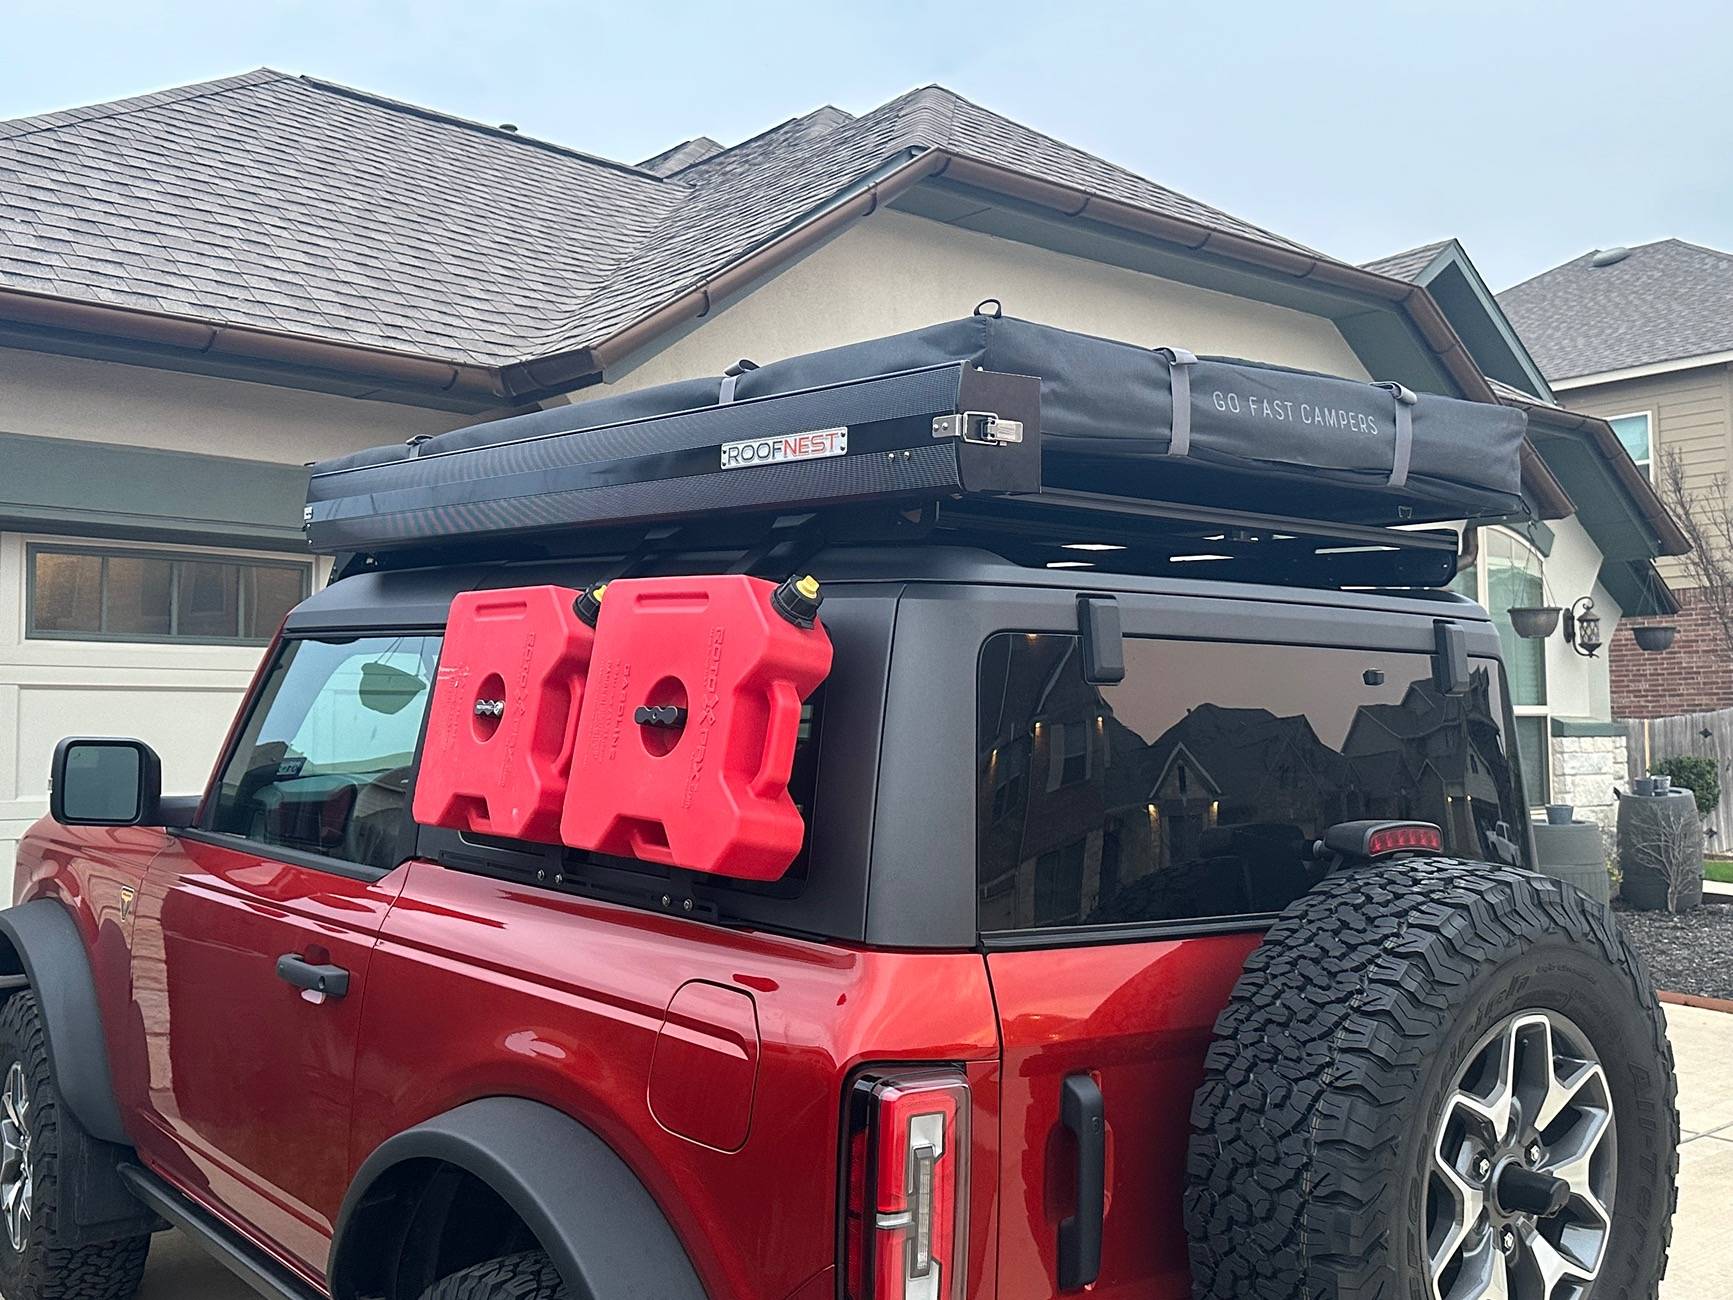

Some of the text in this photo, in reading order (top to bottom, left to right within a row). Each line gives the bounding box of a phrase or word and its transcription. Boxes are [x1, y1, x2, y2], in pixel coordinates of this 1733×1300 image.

[1213, 391, 1378, 434] GO FAST CAMPERS
[727, 433, 839, 465] ROOFNEST
